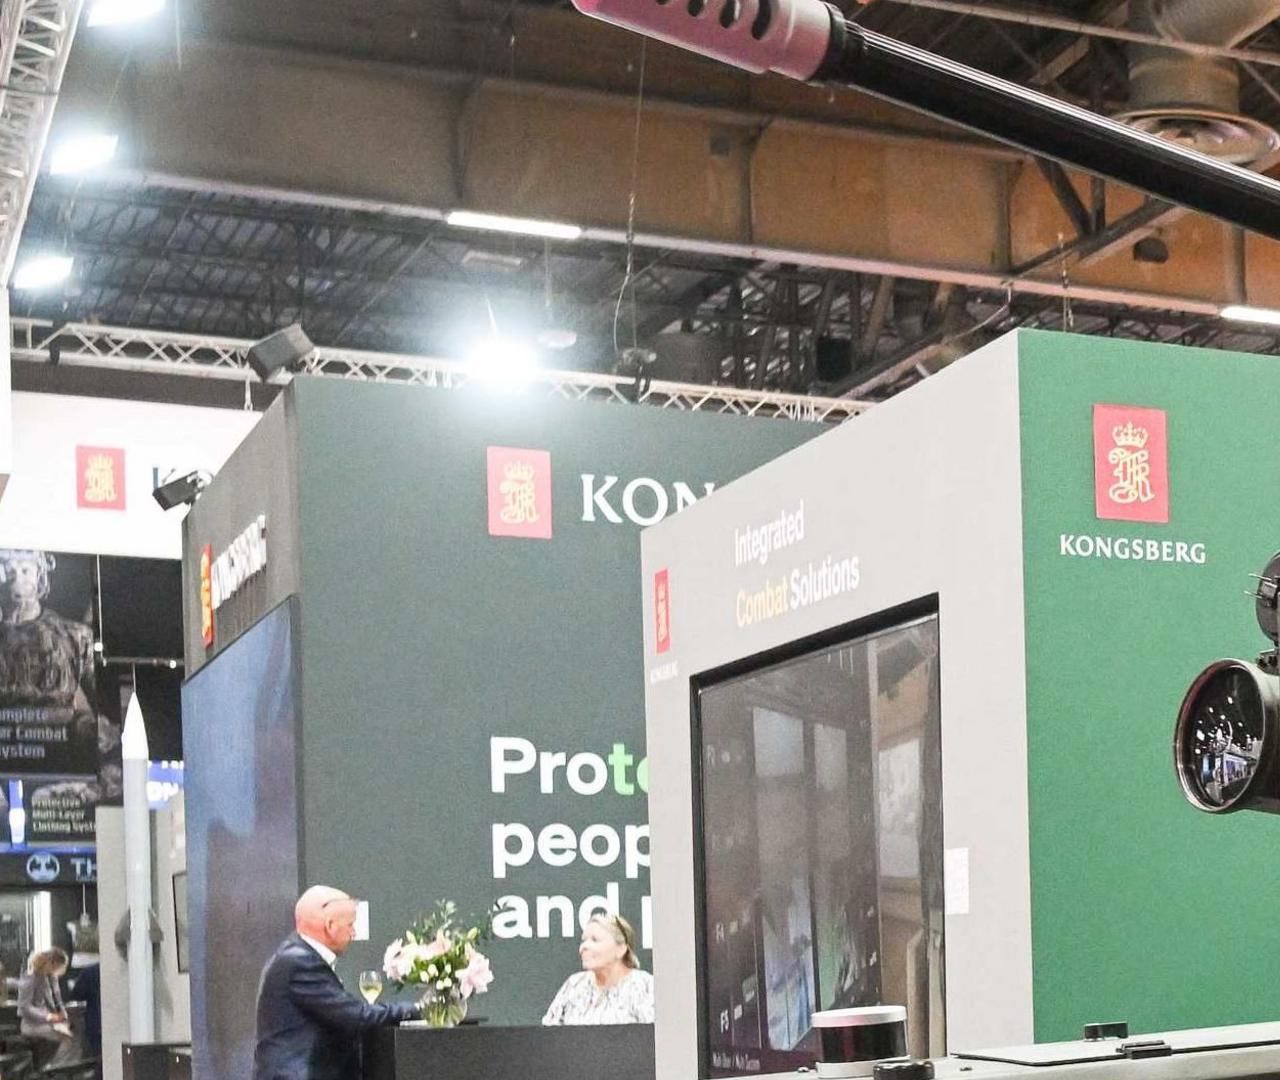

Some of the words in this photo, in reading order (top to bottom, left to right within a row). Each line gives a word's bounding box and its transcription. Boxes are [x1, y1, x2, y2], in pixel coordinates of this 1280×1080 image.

[735, 499, 804, 567] Integrated
[1061, 534, 1206, 563] KONGSBERG
[736, 577, 788, 627] Combat
[790, 554, 860, 609] Solutions
